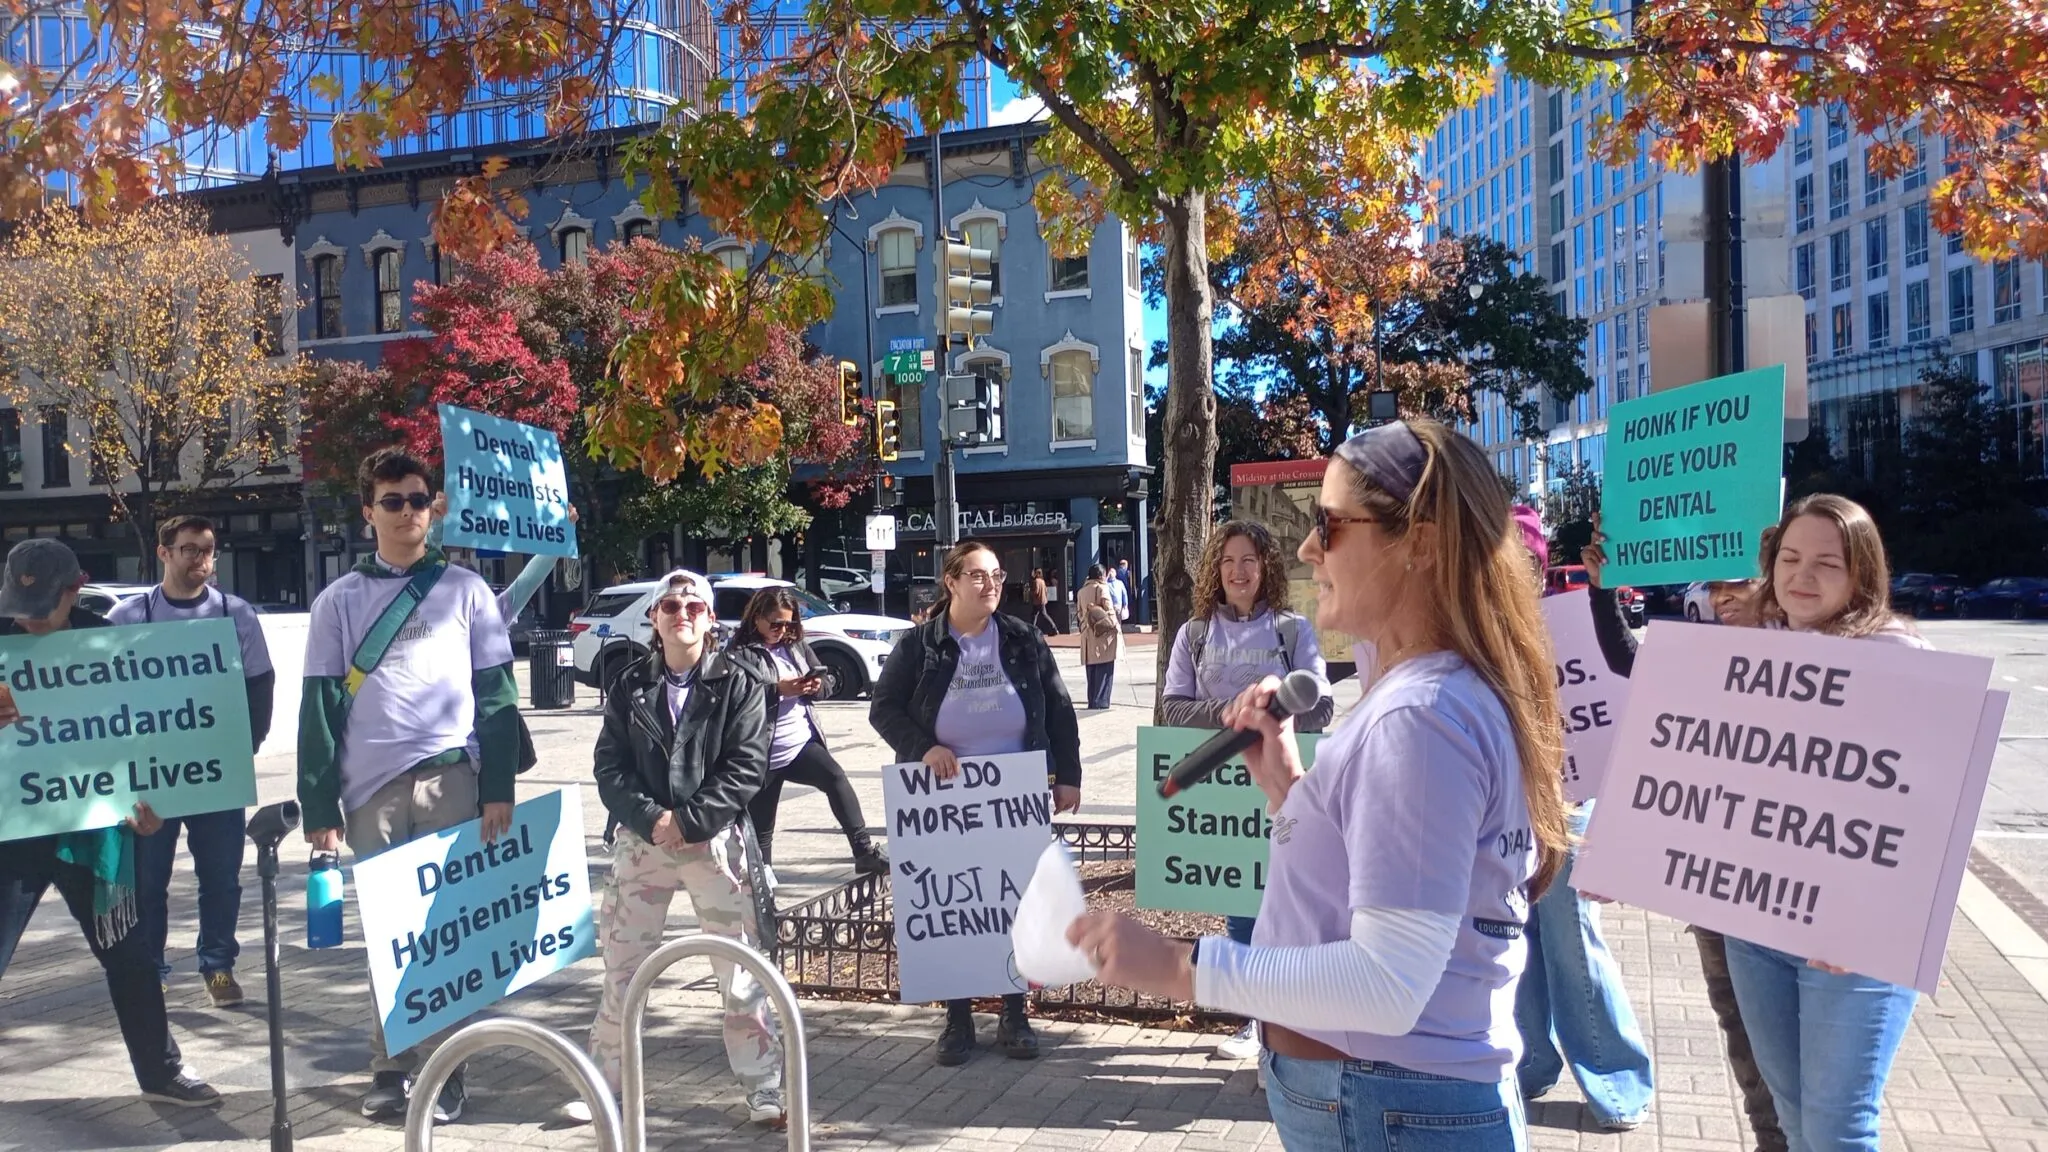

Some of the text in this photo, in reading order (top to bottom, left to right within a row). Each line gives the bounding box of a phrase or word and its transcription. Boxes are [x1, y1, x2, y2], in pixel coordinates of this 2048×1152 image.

[891, 356, 901, 371] 7
[909, 354, 917, 362] ST
[898, 372, 922, 383] 1000
[1624, 395, 1750, 443] HONK IF YOU
[473, 427, 537, 463] Dental
[1627, 442, 1737, 484] LOVE YOUR
[459, 465, 561, 504] Hygienists
[1236, 473, 1266, 485] Midcity
[1269, 473, 1277, 481] at
[1278, 471, 1291, 480] the
[908, 512, 1000, 532] CATAL
[1003, 512, 1066, 527] BURGER
[1639, 492, 1717, 522] DENTAL
[460, 509, 565, 544] Save Lives
[1616, 532, 1744, 566] HYGIENIST!!!
[962, 661, 994, 676] Raise
[1725, 655, 1851, 707] RAISE
[16, 698, 215, 747] Standards
[1651, 713, 1911, 794] STANDARDS.
[20, 756, 222, 805] Save Lives
[962, 761, 1000, 788] DO
[897, 792, 1050, 837] MORE THAN
[1632, 774, 1906, 869] DON'T ERASE
[417, 825, 534, 896] Dental
[1498, 827, 1532, 859] ORAL
[1000, 868, 1021, 901] A
[1165, 855, 1241, 888] Save
[1663, 849, 1821, 925] THEM!!!
[392, 871, 570, 969] Hygienists
[404, 924, 574, 1024] Save Lives
